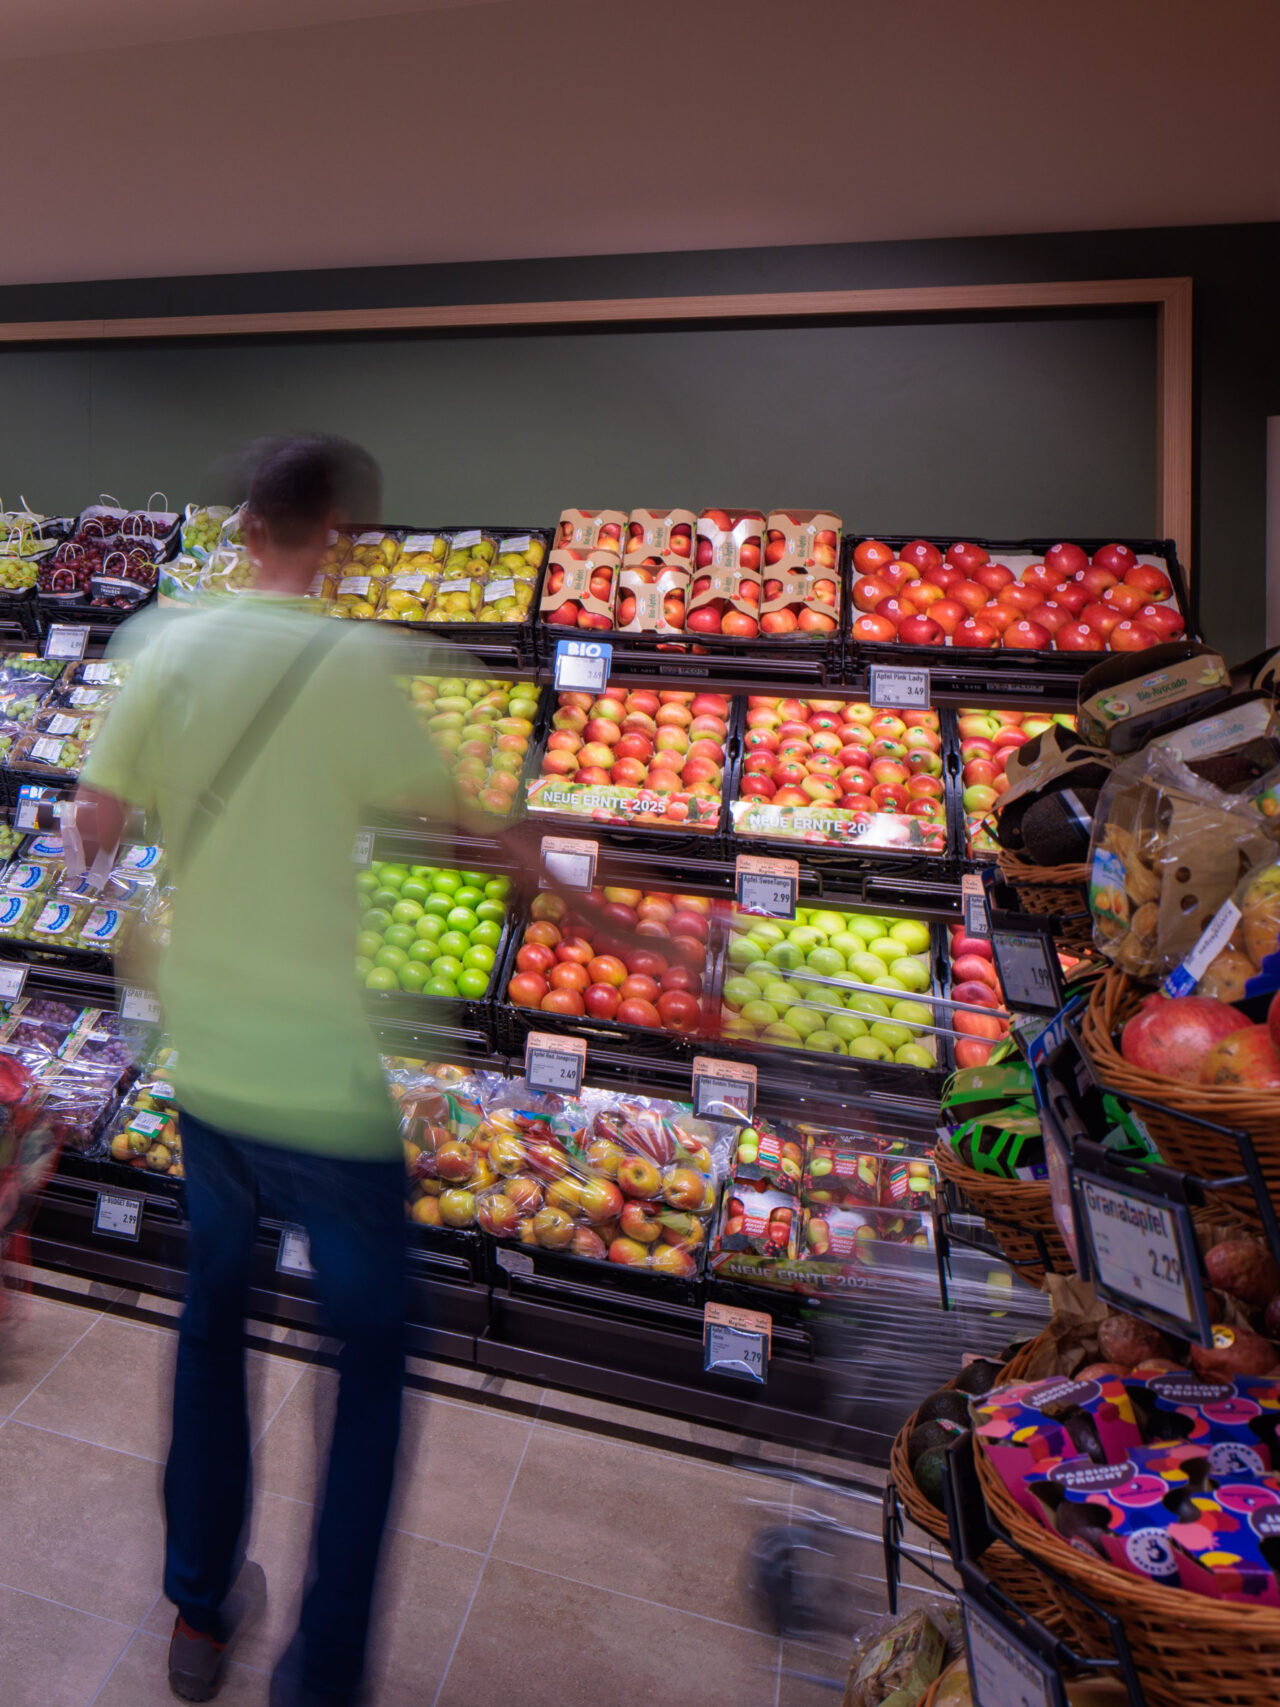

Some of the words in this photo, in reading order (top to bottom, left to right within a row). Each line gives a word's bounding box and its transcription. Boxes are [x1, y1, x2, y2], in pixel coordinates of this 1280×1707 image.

[567, 642, 602, 657] BIO
[877, 672, 892, 683] Apfel
[893, 673, 908, 682] Pink
[909, 674, 924, 686] Lady
[907, 687, 924, 696] 3.49
[1136, 677, 1188, 702] Bio-Avocado
[543, 791, 578, 805] NEUE
[583, 795, 628, 810] ERNTE
[631, 799, 666, 813] 2025
[749, 814, 789, 829] NEUE
[793, 817, 842, 833] ERNTE
[743, 874, 758, 886] Apfel
[773, 892, 790, 904] 2.99
[1031, 967, 1049, 986] 1.99
[126, 988, 143, 1000] SPAR
[561, 1069, 577, 1080] 2.49
[1086, 1184, 1168, 1238] Granatapfel
[122, 1213, 137, 1225] 2.99
[1148, 1248, 1181, 1286] 2.29
[730, 1263, 771, 1279] NEUE
[777, 1270, 831, 1286] ERNTE
[744, 1350, 762, 1363] 2.79
[1154, 1382, 1230, 1393] PASSIONS
[1163, 1389, 1222, 1398] FRUCHT
[1055, 1463, 1129, 1482] PASSIONS
[1066, 1471, 1124, 1486] FRUCHT
